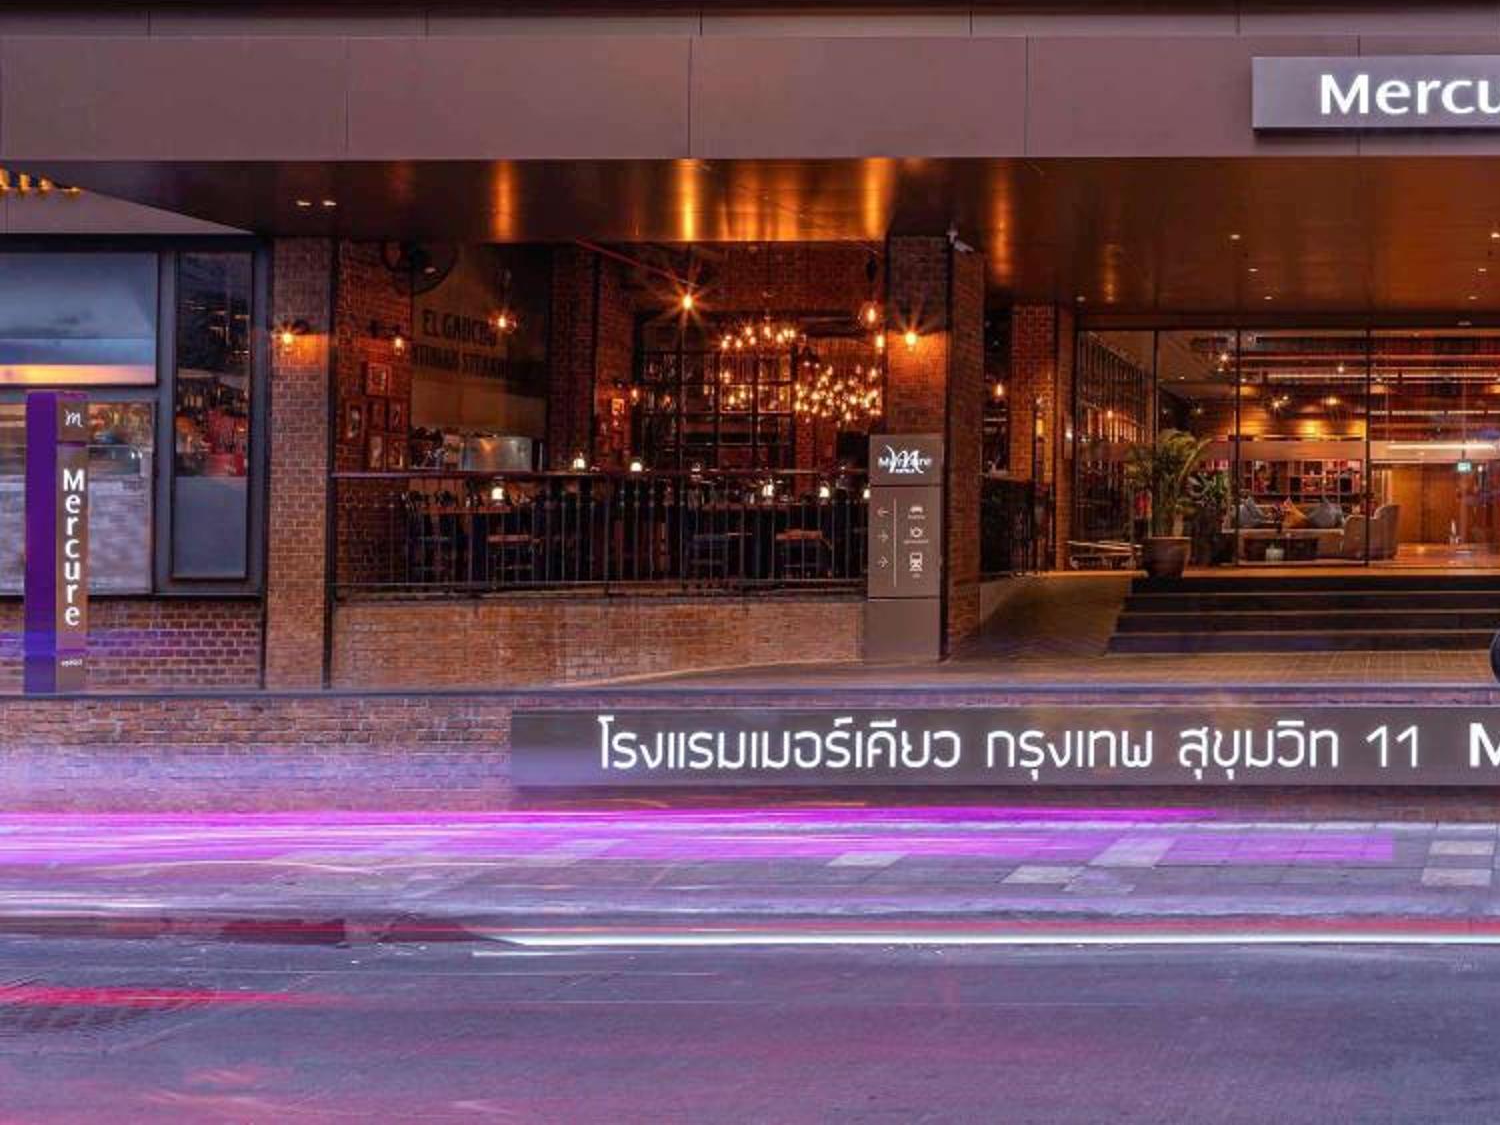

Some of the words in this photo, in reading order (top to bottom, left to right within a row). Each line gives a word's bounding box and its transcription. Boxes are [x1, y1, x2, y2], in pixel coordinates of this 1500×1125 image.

[63, 468, 85, 626] Mercure
[597, 713, 961, 770] โรงแรมเมอร์เคียว
[984, 726, 1154, 782] กรุงเทพ
[1177, 719, 1340, 781] สุขุมวิท
[1365, 725, 1418, 767] 11
